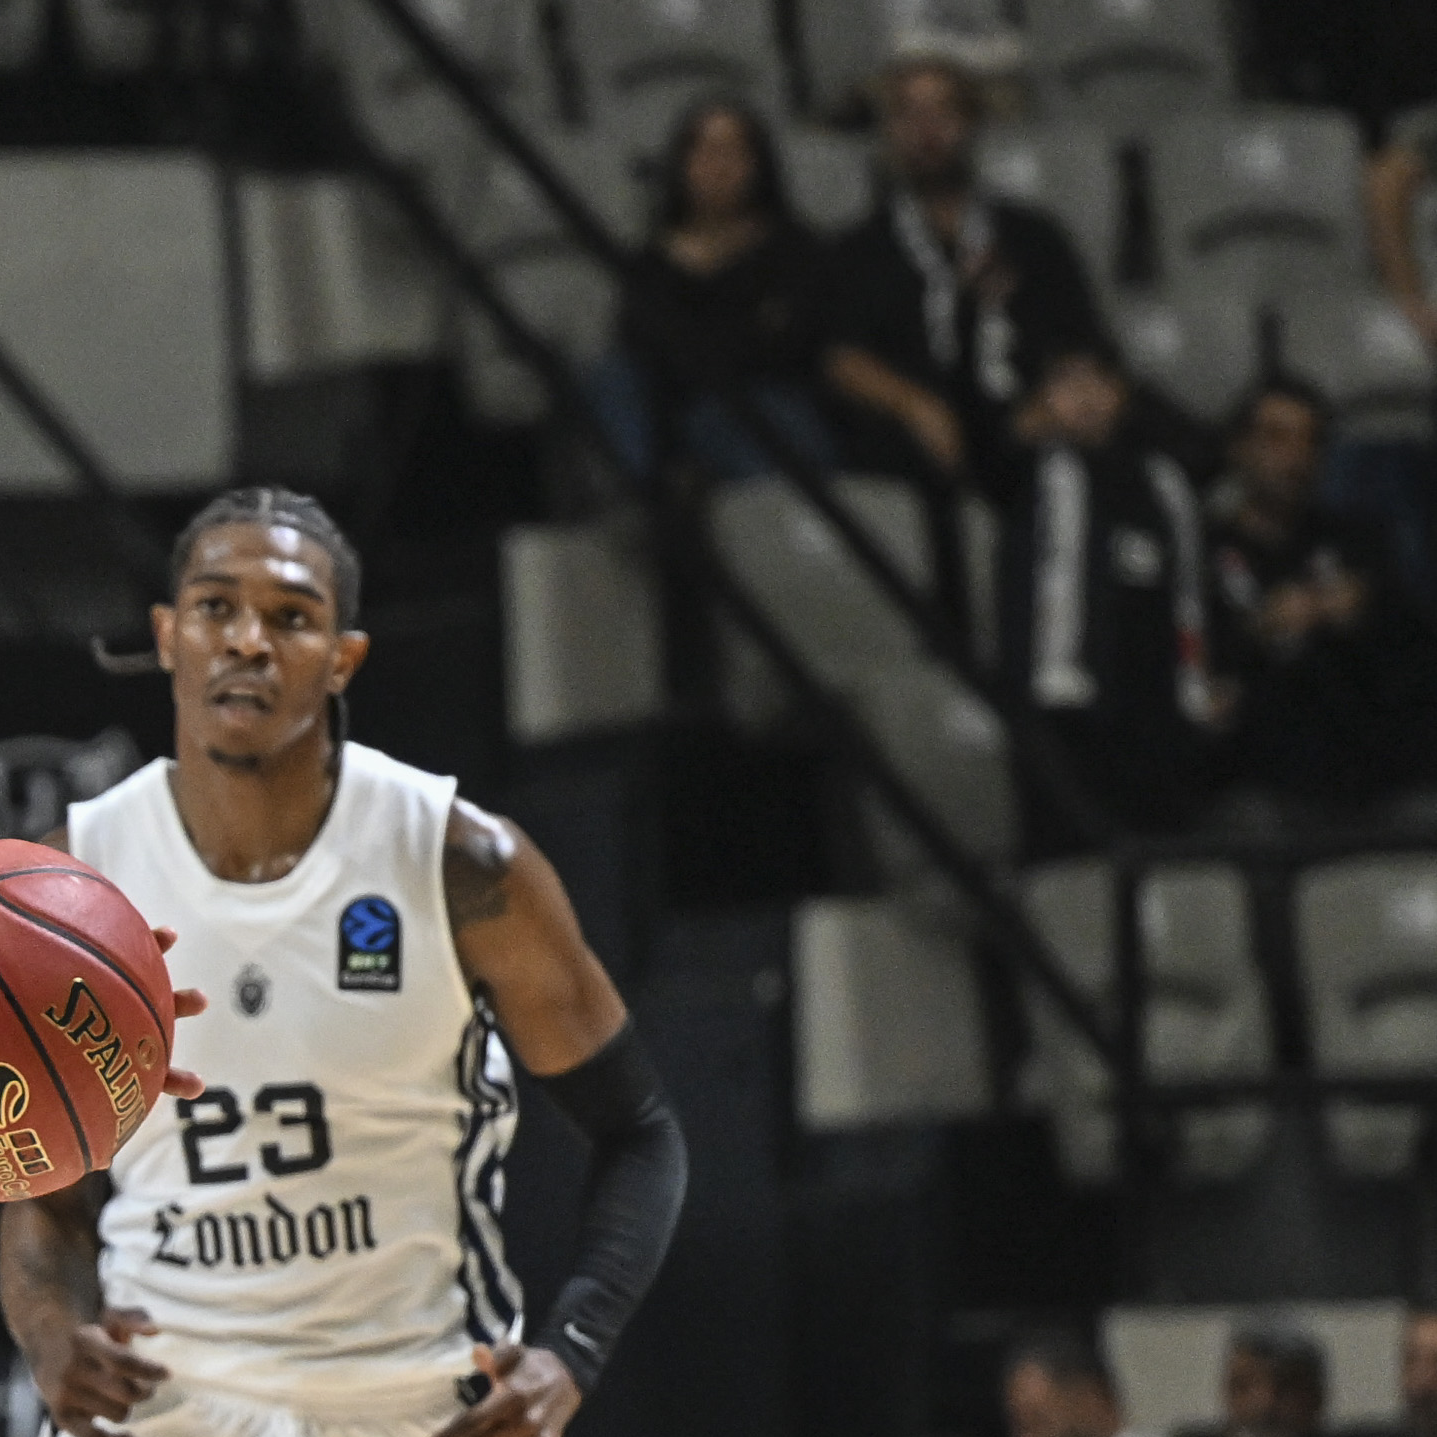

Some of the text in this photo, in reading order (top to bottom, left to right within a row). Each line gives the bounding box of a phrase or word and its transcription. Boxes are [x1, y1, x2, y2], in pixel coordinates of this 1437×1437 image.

[41, 977, 147, 1148] SPALDI
[177, 1081, 332, 1185] 23
[151, 1193, 378, 1270] London
